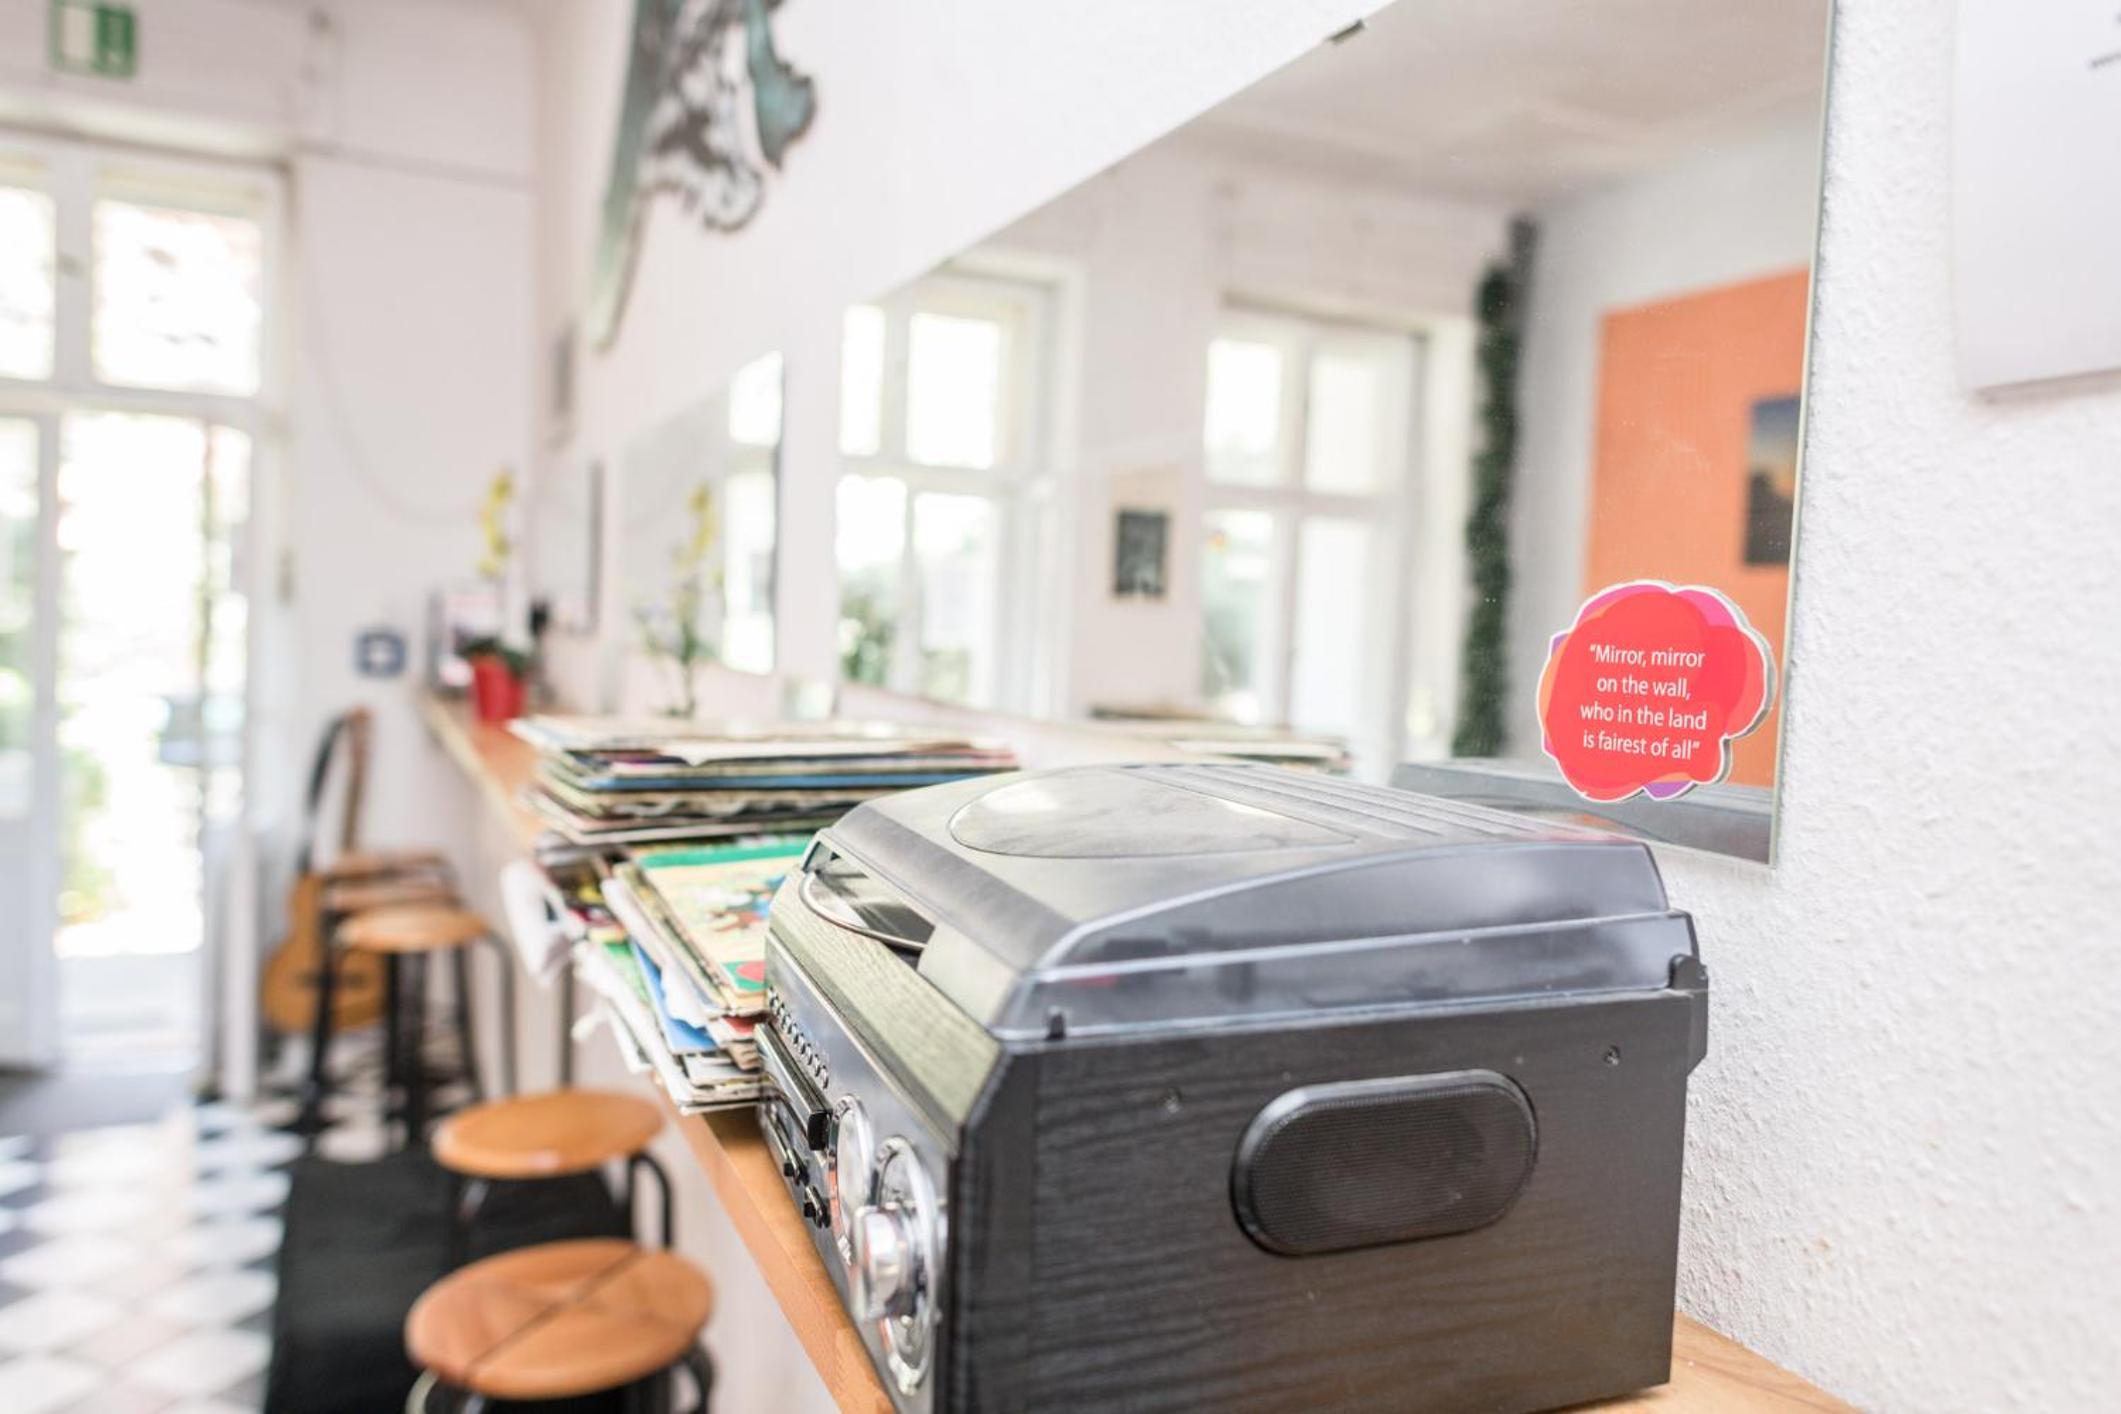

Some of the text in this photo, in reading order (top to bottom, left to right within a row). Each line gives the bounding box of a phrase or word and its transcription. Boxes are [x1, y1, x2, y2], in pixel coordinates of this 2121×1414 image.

[1589, 643, 1706, 668] “Mirror, mirror
[1597, 675, 1691, 700] on the wall,
[1580, 702, 1707, 730] who in the land
[1583, 730, 1700, 760] is fairest of all”
